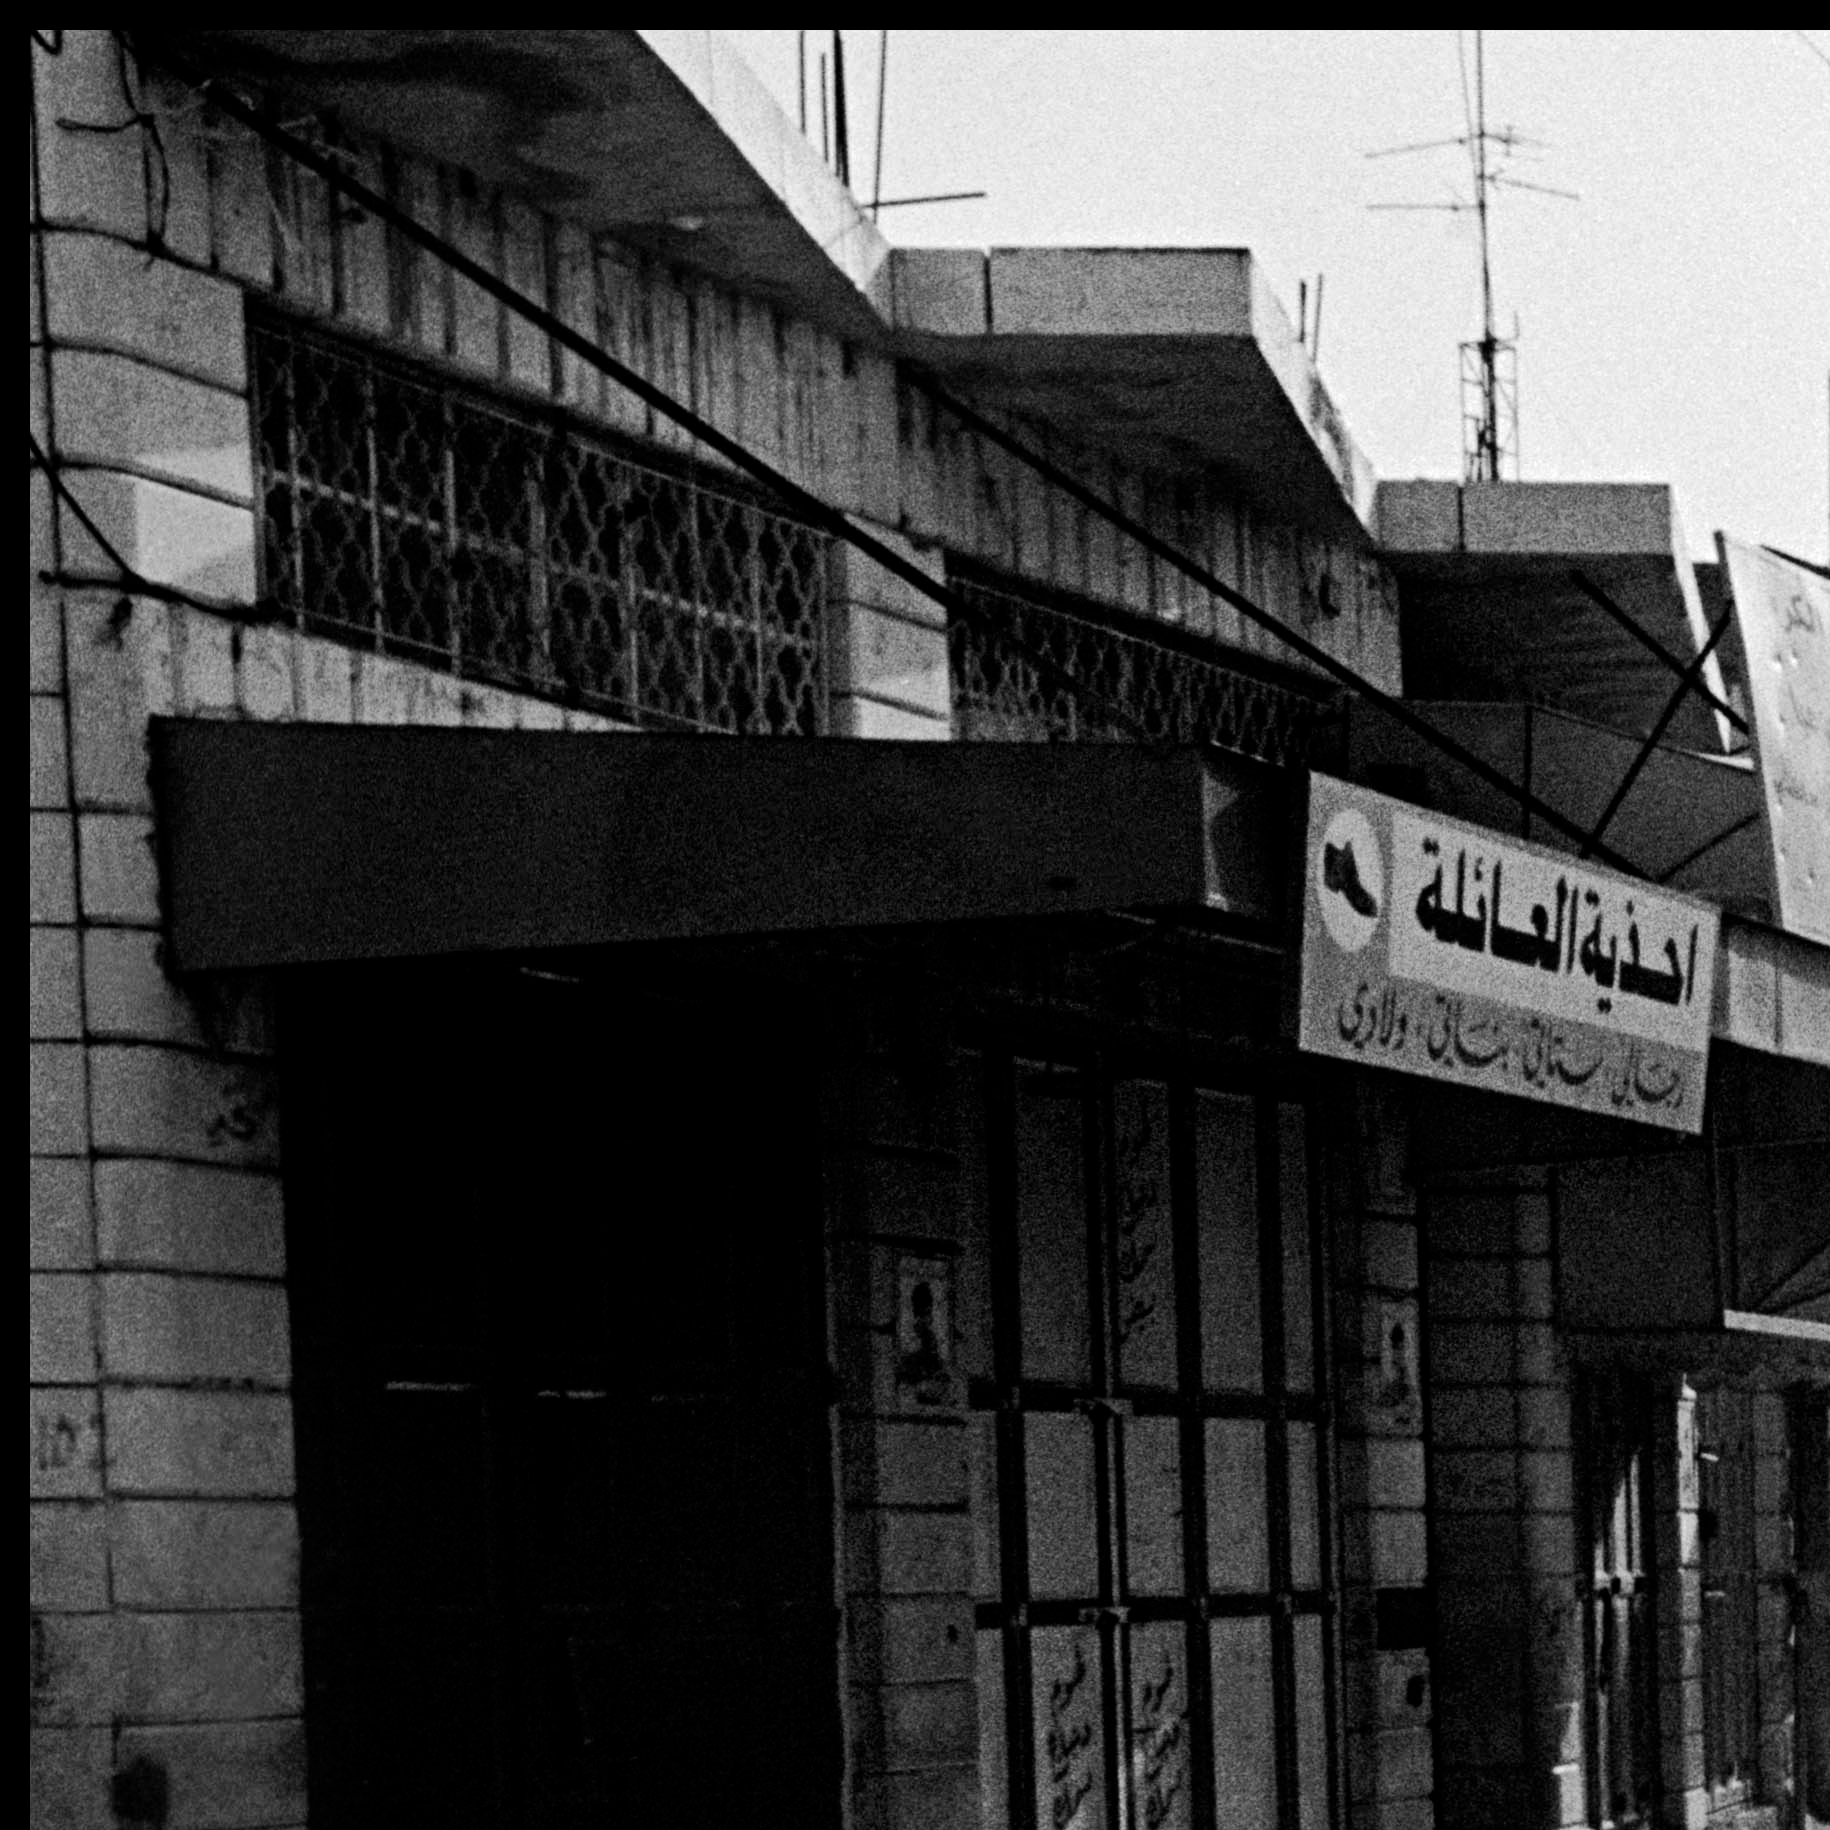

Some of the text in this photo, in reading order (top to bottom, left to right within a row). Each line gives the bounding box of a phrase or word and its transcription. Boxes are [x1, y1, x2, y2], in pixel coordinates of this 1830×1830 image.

[1414, 836, 1578, 974] العائلة
[1579, 889, 1698, 1014] احذية
[1337, 981, 1408, 1052] ولادي
[1610, 1040, 1684, 1108] رجالي
